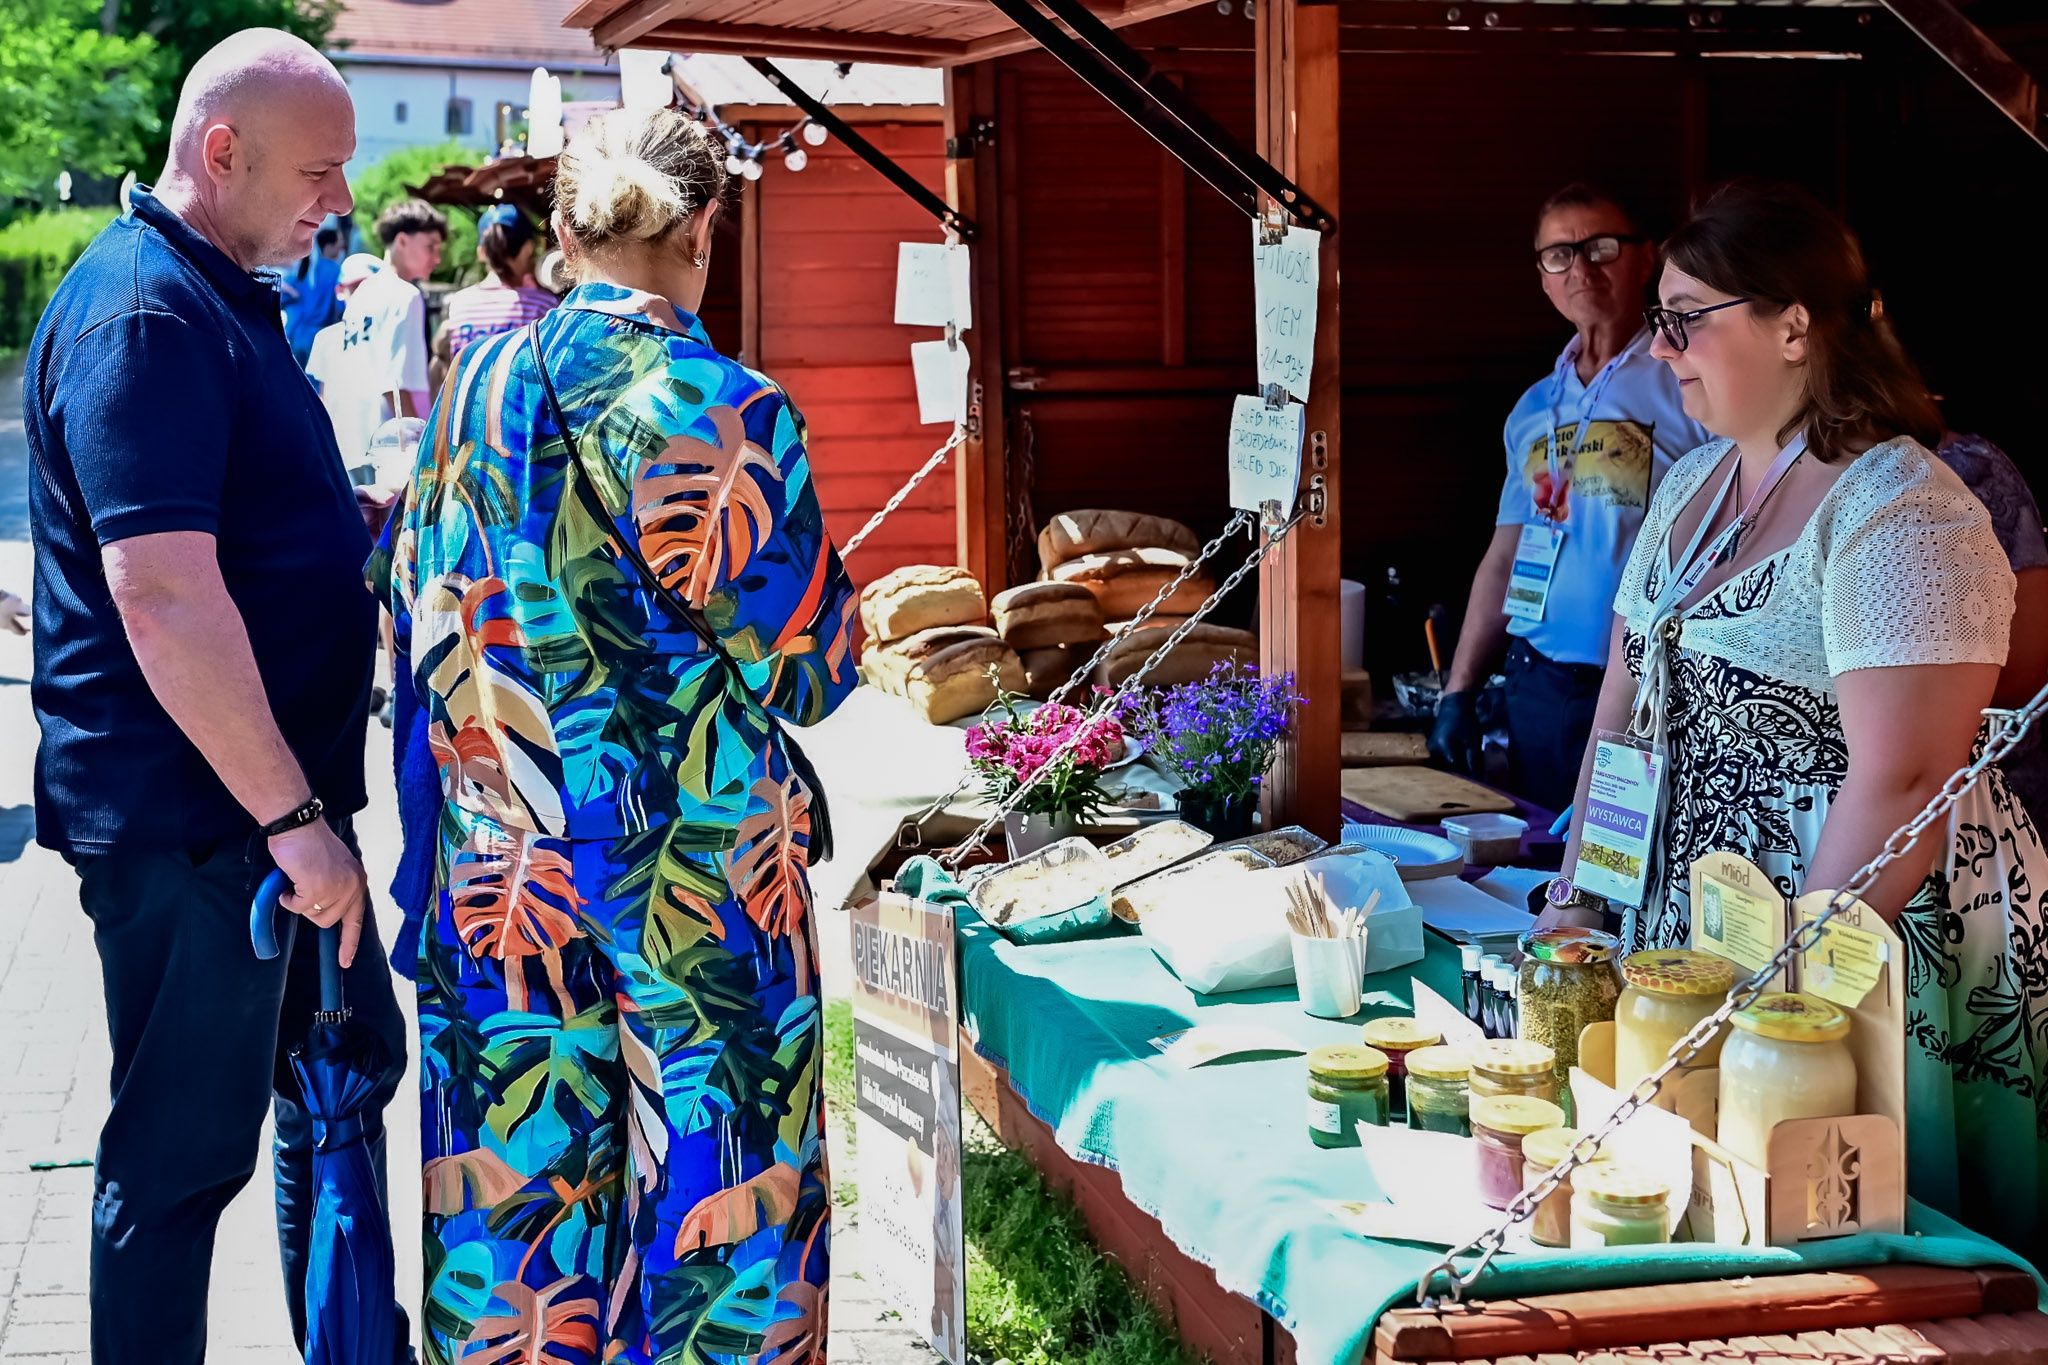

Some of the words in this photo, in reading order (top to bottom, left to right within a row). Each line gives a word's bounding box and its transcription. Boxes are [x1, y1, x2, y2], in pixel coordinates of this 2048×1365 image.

[1588, 804, 1642, 833] WYSTAWCA
[1721, 861, 1750, 888] Miód
[853, 921, 950, 1014] PIEKARNIA
